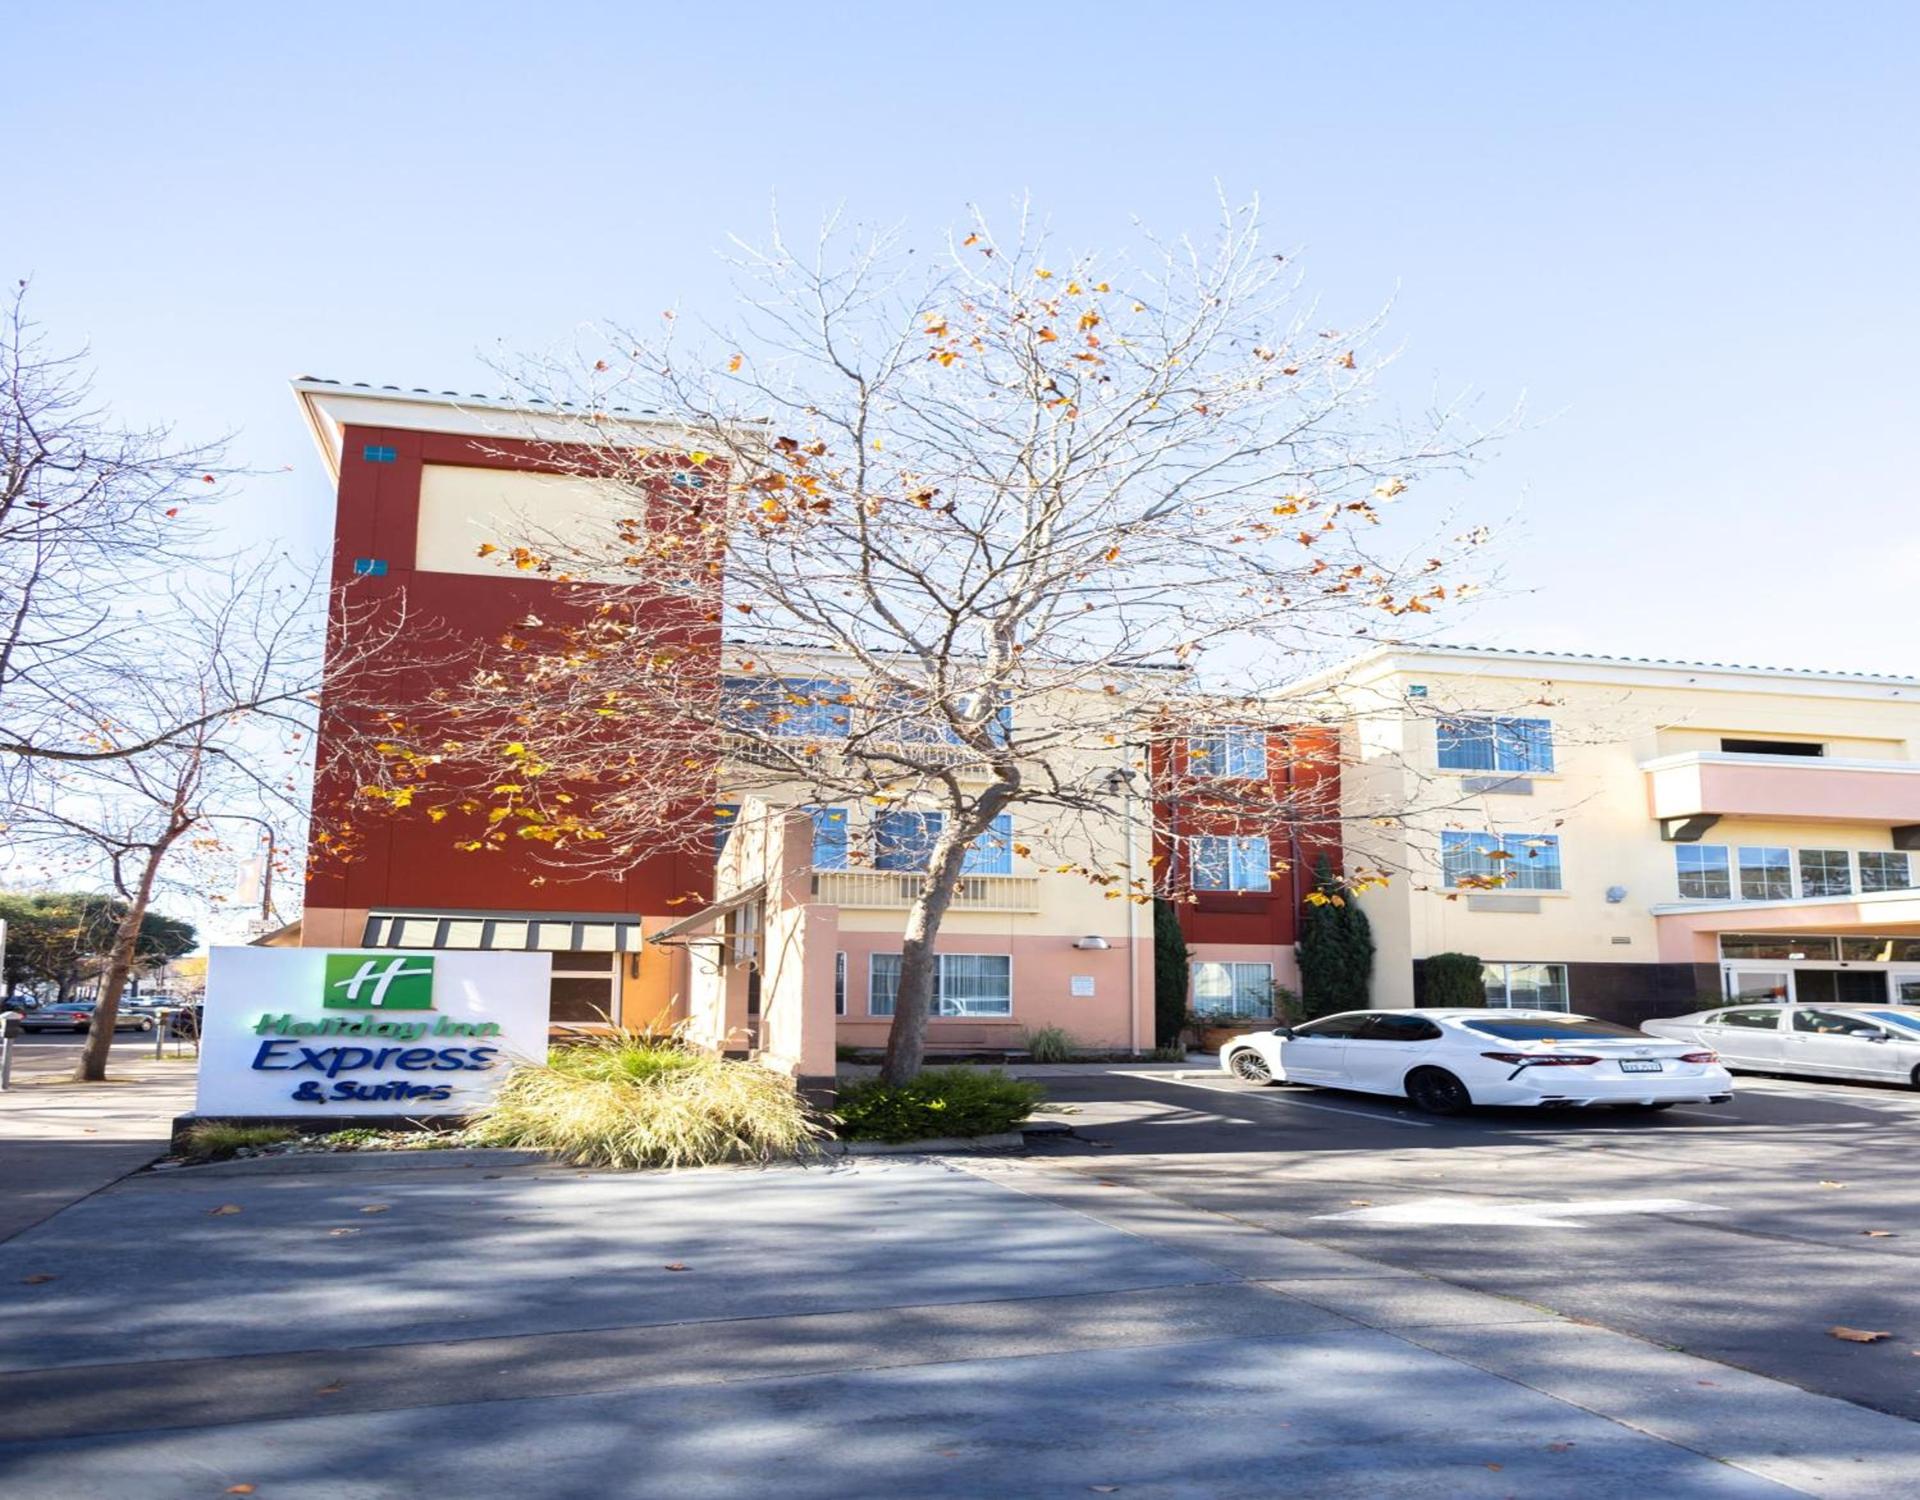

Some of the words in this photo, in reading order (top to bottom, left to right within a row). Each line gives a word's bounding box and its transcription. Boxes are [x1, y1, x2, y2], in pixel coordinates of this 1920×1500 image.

[253, 1013, 428, 1042] Holiday
[431, 1015, 500, 1038] Inn
[251, 1039, 499, 1079] Express
[291, 1080, 325, 1102] &
[328, 1081, 453, 1102] Suites
